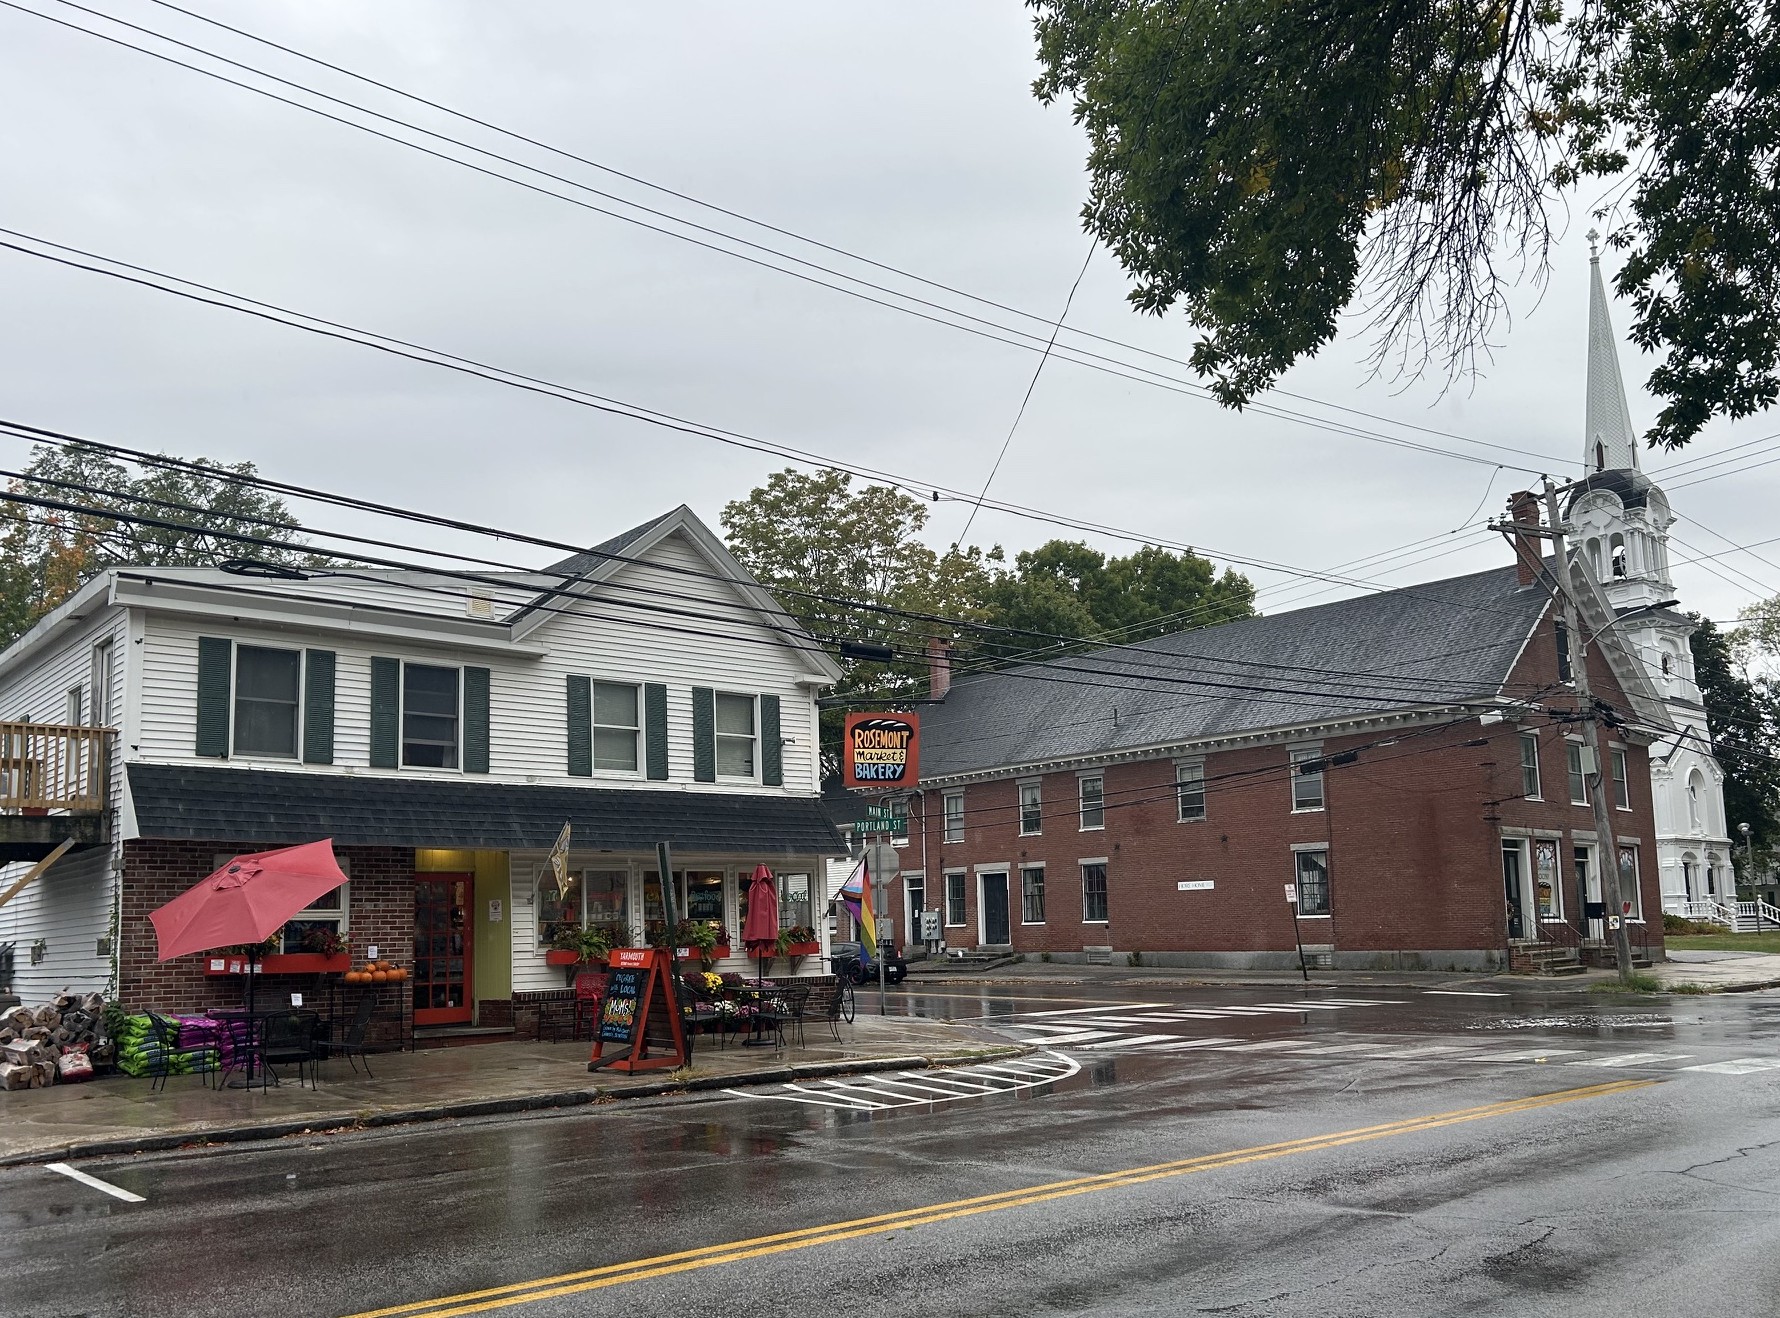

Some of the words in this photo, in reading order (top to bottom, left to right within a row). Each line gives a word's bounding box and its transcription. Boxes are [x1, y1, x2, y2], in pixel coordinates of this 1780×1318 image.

[854, 729, 909, 748] ROSEMONT
[855, 750, 898, 762] Market
[855, 763, 904, 779] BAKERY
[868, 806, 882, 817] MAIN
[883, 808, 890, 818] ST
[856, 820, 890, 832] PORTLAND
[893, 820, 901, 830] ST
[620, 952, 645, 961] YARMOUTH
[620, 984, 635, 994] LOCAL
